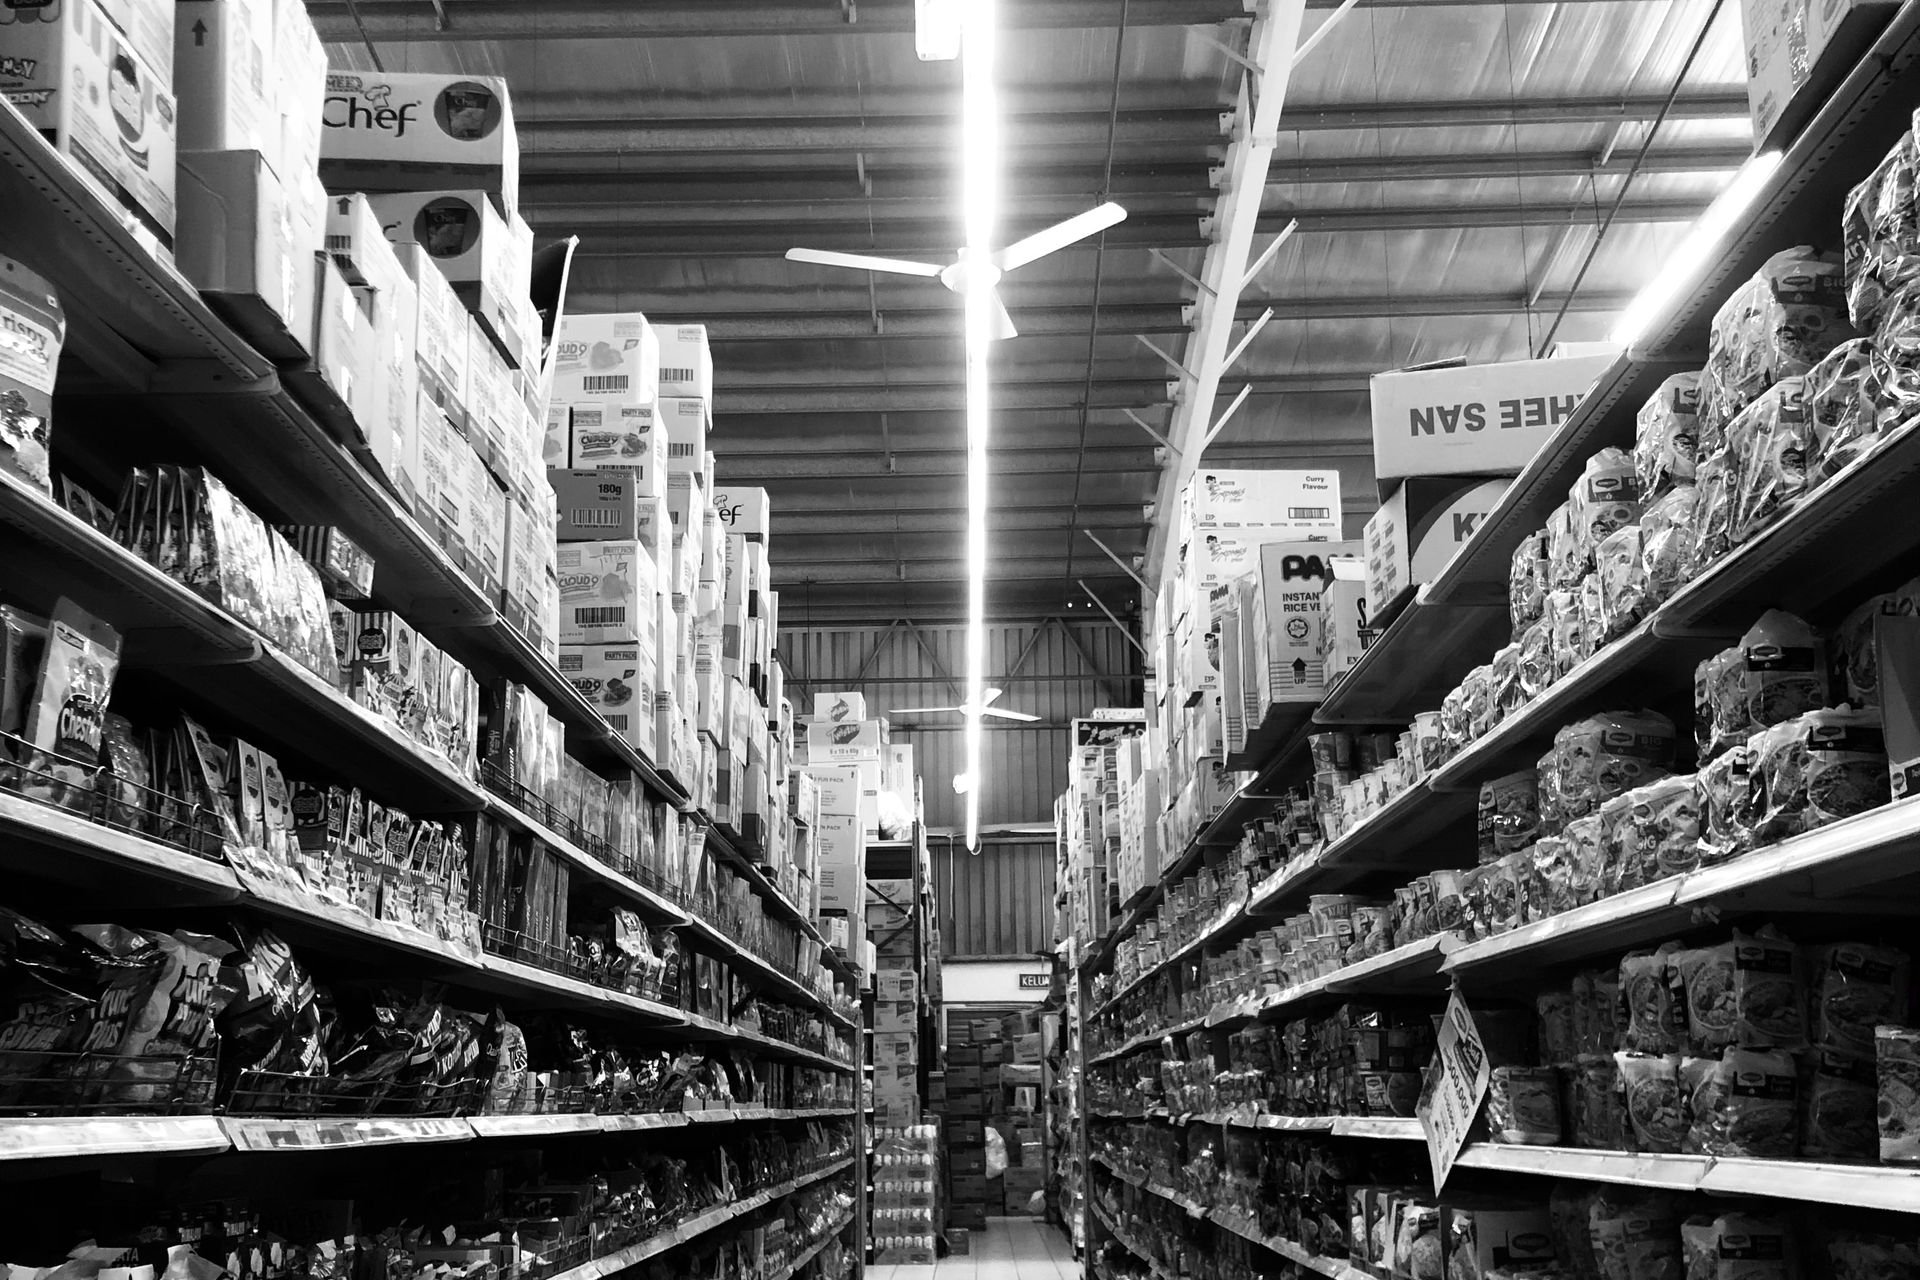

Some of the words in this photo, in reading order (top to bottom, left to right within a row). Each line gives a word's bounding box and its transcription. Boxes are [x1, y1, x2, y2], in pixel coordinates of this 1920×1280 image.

[322, 97, 417, 137] Chef
[2, 313, 47, 350] rispy
[1409, 402, 1486, 437] SAN
[598, 484, 622, 495] 180g
[719, 504, 742, 526] ef
[1453, 513, 1488, 542] K
[1284, 603, 1308, 612] RICE
[1022, 976, 1049, 986] KELUA
